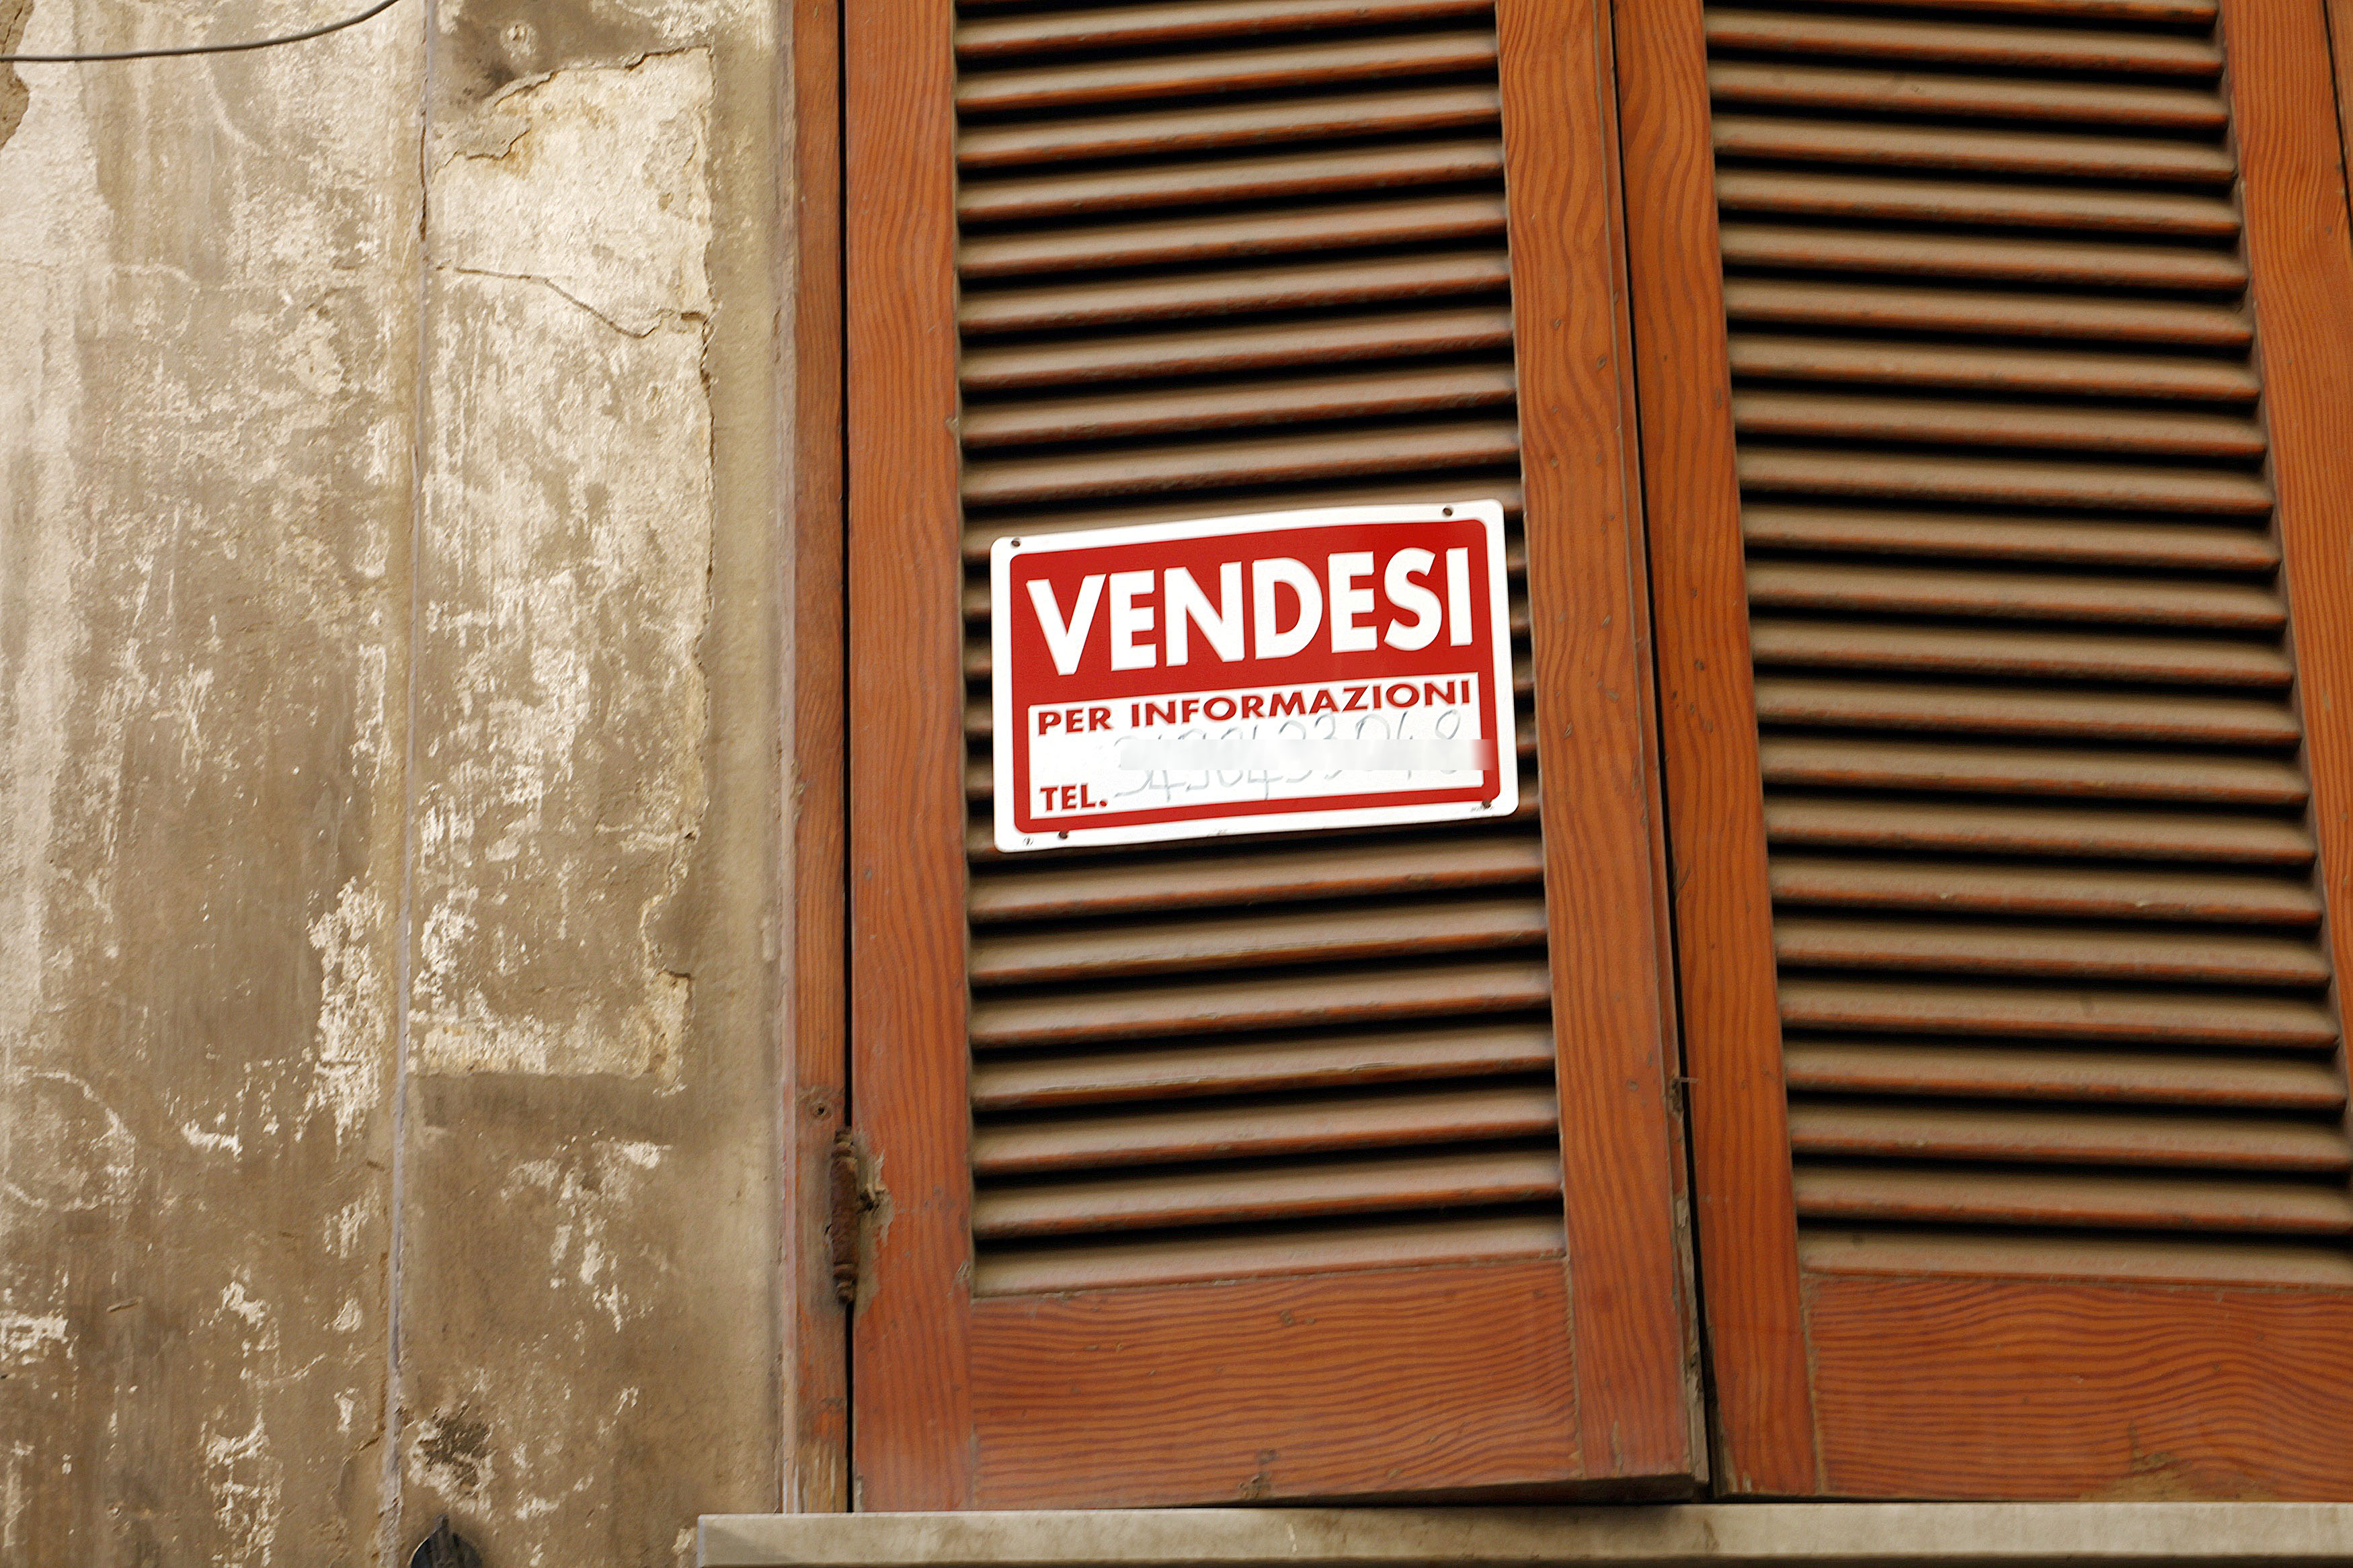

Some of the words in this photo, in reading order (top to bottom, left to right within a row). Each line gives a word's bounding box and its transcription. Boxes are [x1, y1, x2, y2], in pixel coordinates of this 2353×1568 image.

[1026, 546, 1474, 676] VENDESI
[1037, 706, 1113, 737] PER
[1130, 680, 1472, 729] INFORMAZIONI
[1039, 784, 1109, 812] TEL.
